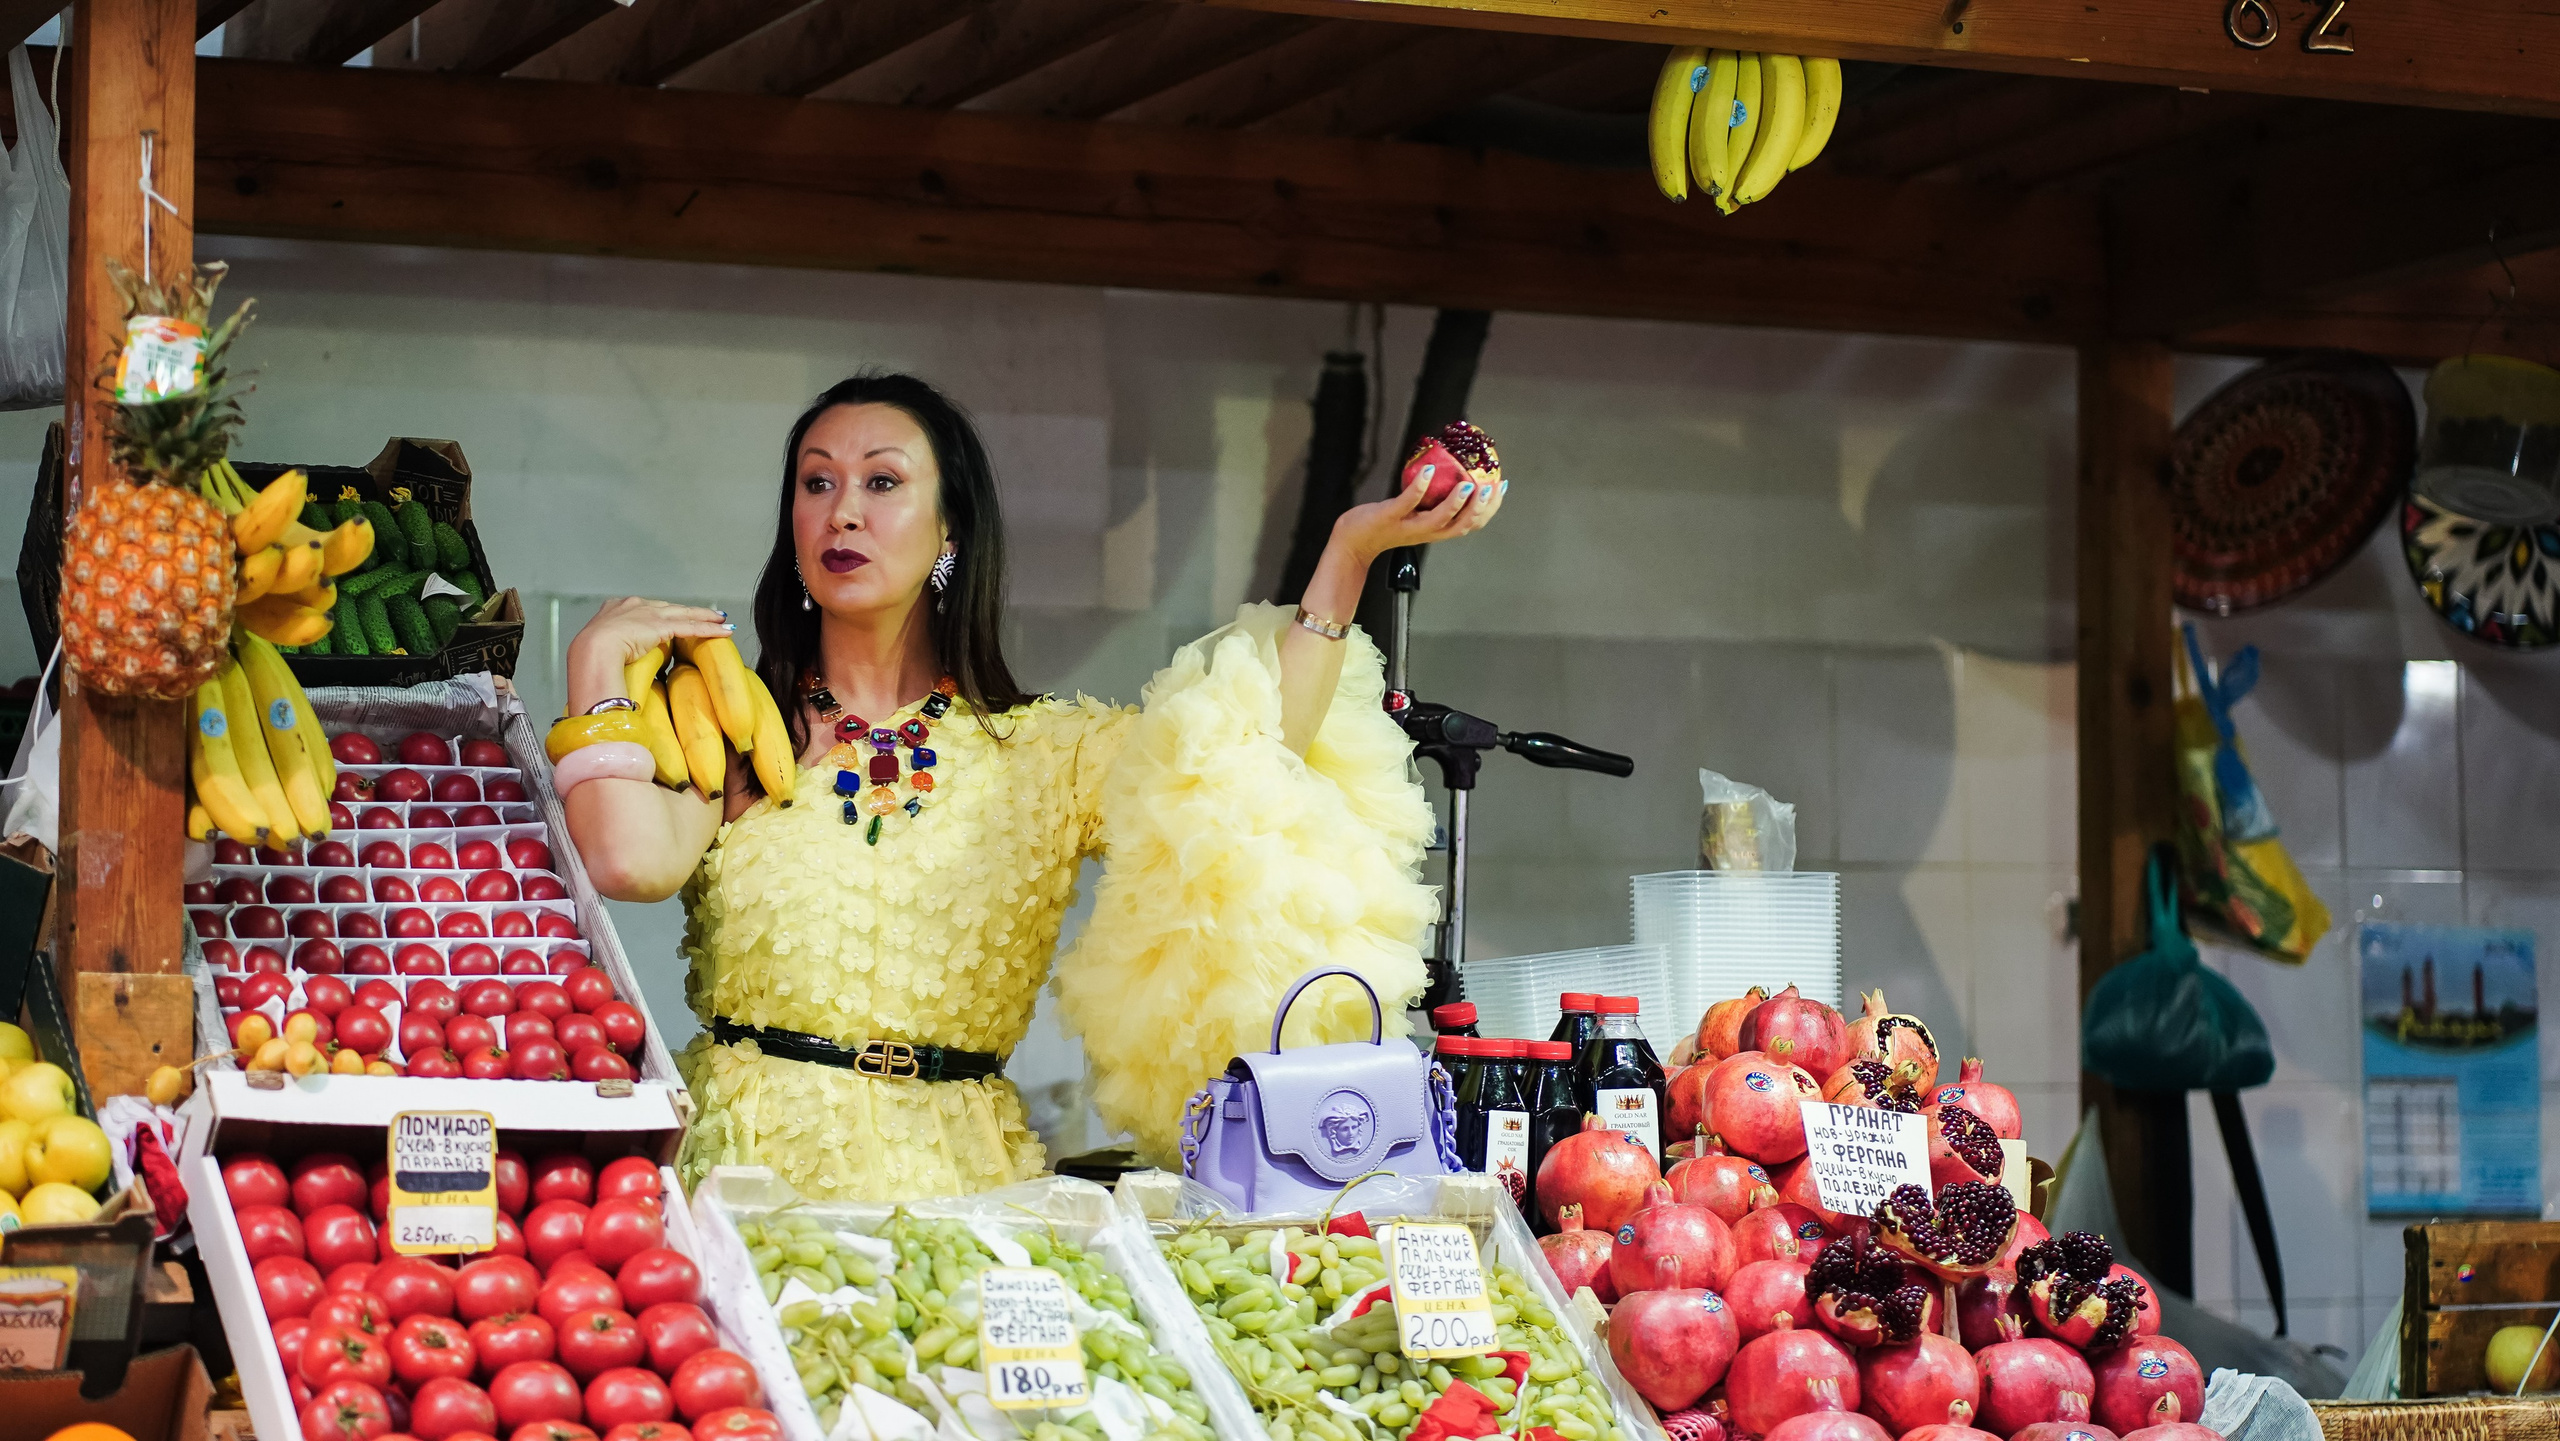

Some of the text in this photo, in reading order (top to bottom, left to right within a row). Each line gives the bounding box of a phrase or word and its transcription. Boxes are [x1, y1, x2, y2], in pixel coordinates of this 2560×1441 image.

[400, 1115, 492, 1136] ПОМИДОР
[1610, 1121, 1651, 1129] ГРАНАТОВЫЙ
[1828, 1104, 1903, 1132] ГРАНАТ
[1832, 1143, 1908, 1170] ФЕРГАНА
[1823, 1177, 1886, 1197] ПОЛЕЗНО
[421, 1193, 471, 1206] ЦЕНА
[1398, 1226, 1470, 1248] ДАМСКИЕ
[1401, 1247, 1472, 1263] ПАЛЬЧИК
[1407, 1278, 1482, 1297] ФЕРГАНА
[1424, 1301, 1467, 1312] ЦЕНА
[990, 1325, 1068, 1344] ФЕРГАНА
[1012, 1349, 1058, 1361] ЦЕНА
